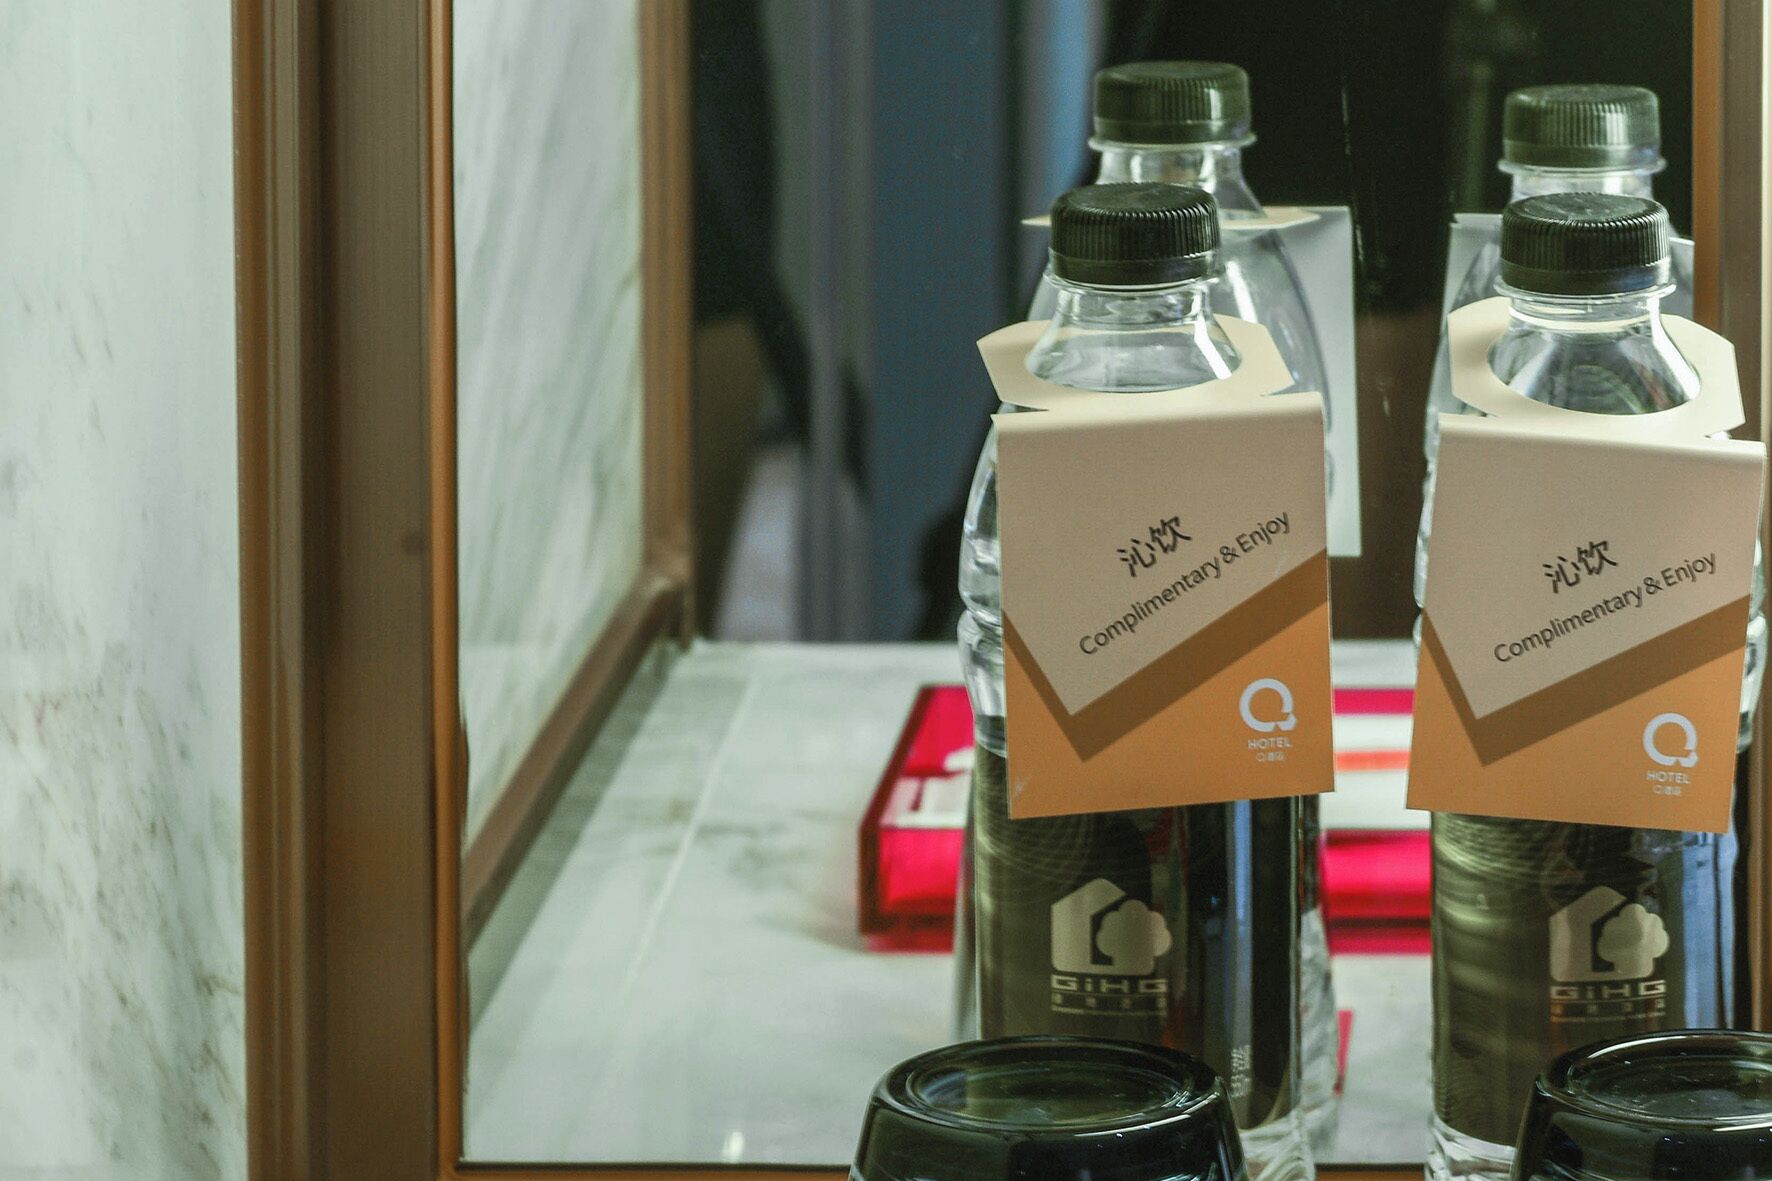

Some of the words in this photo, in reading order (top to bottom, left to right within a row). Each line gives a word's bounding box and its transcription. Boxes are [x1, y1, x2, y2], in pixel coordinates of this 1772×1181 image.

[1116, 516, 1192, 577] 沁饮
[1542, 540, 1619, 593] 沁饮
[1079, 556, 1221, 654] Complimentary
[1219, 545, 1240, 564] &
[1235, 511, 1290, 554] Enjoy
[1493, 586, 1643, 662] Complimentary
[1643, 577, 1664, 595] &
[1660, 553, 1716, 588] Enjoy
[1247, 737, 1292, 750] HOTEL
[1646, 770, 1692, 785] HOTEL
